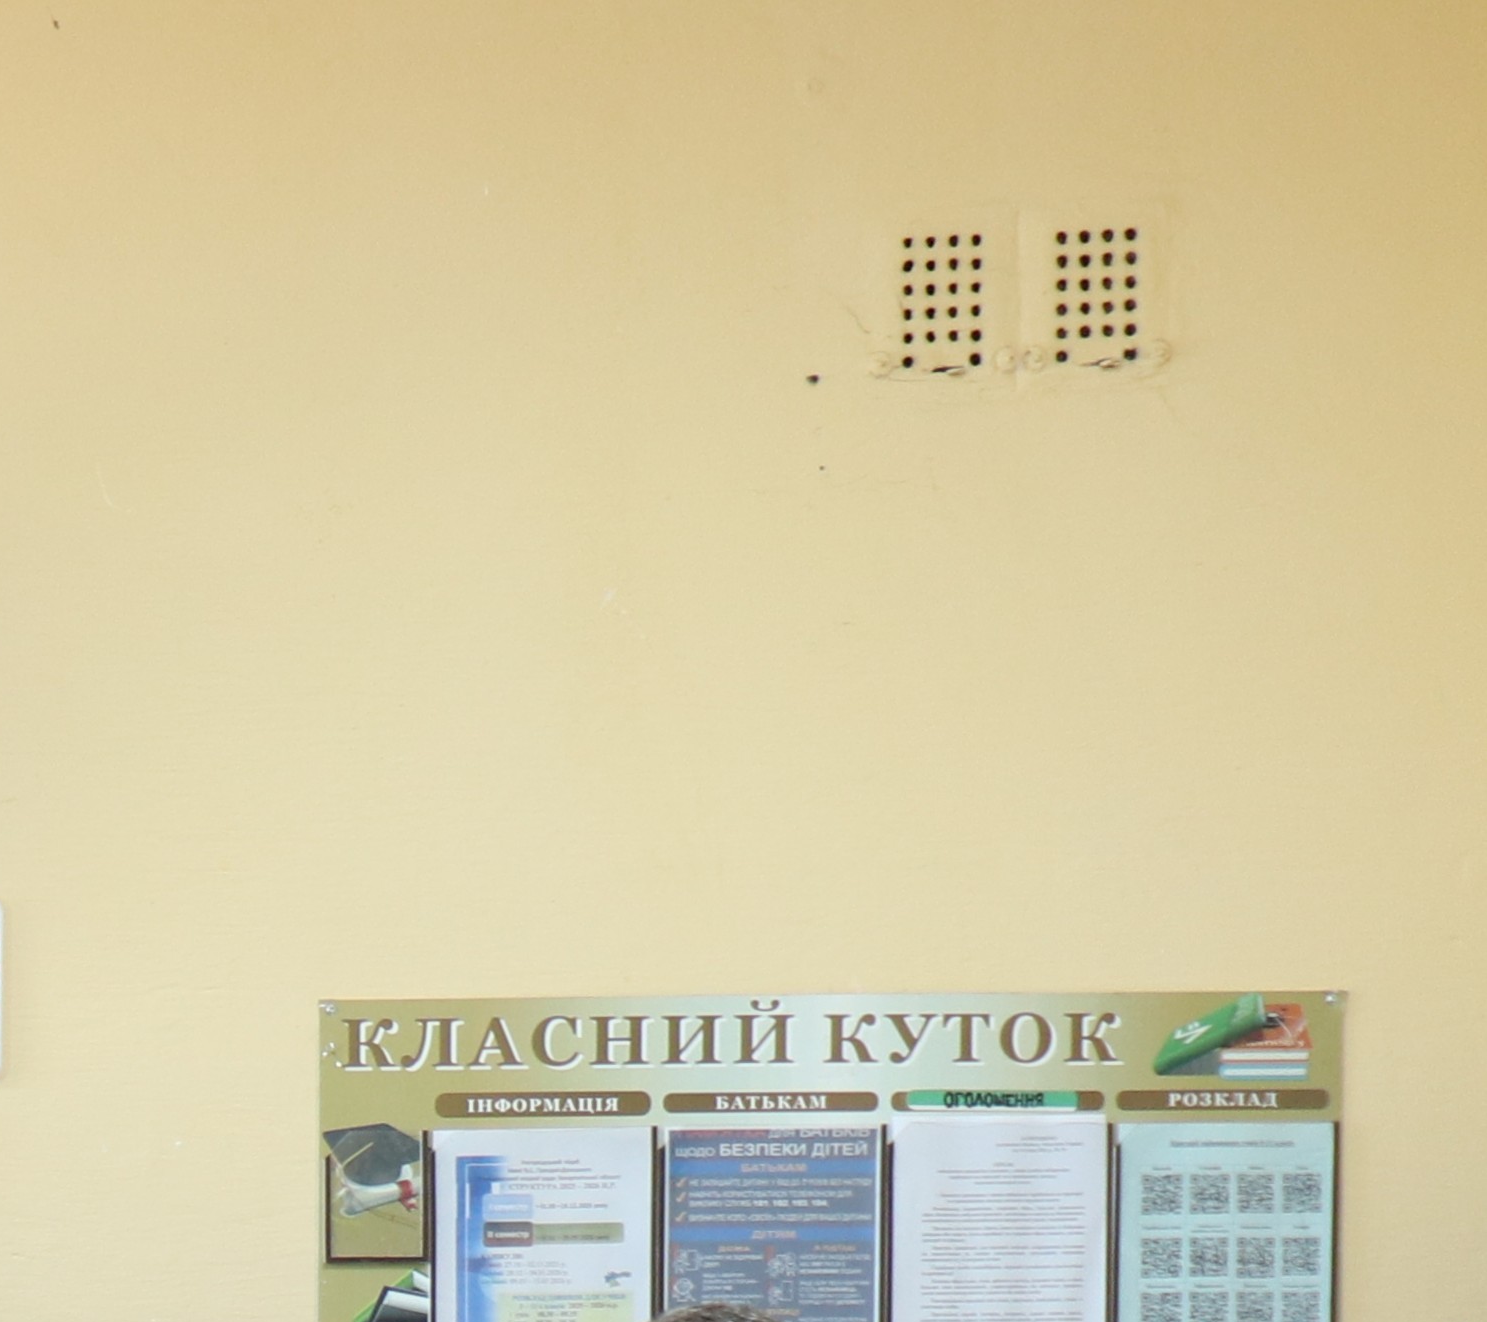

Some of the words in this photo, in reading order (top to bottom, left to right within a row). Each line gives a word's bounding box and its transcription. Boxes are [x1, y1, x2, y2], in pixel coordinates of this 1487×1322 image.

[340, 999, 800, 1072] КЛАСНИЙ
[822, 1011, 1125, 1067] КУТОК
[467, 1095, 620, 1116] ІНФОРМАЦІЯ
[714, 1094, 828, 1112] БАТЬКАМ
[1168, 1091, 1279, 1109] РОЗКЛАД
[718, 1142, 807, 1157] БЕЗПЕКИ
[811, 1140, 869, 1159] ДІТЕЙ
